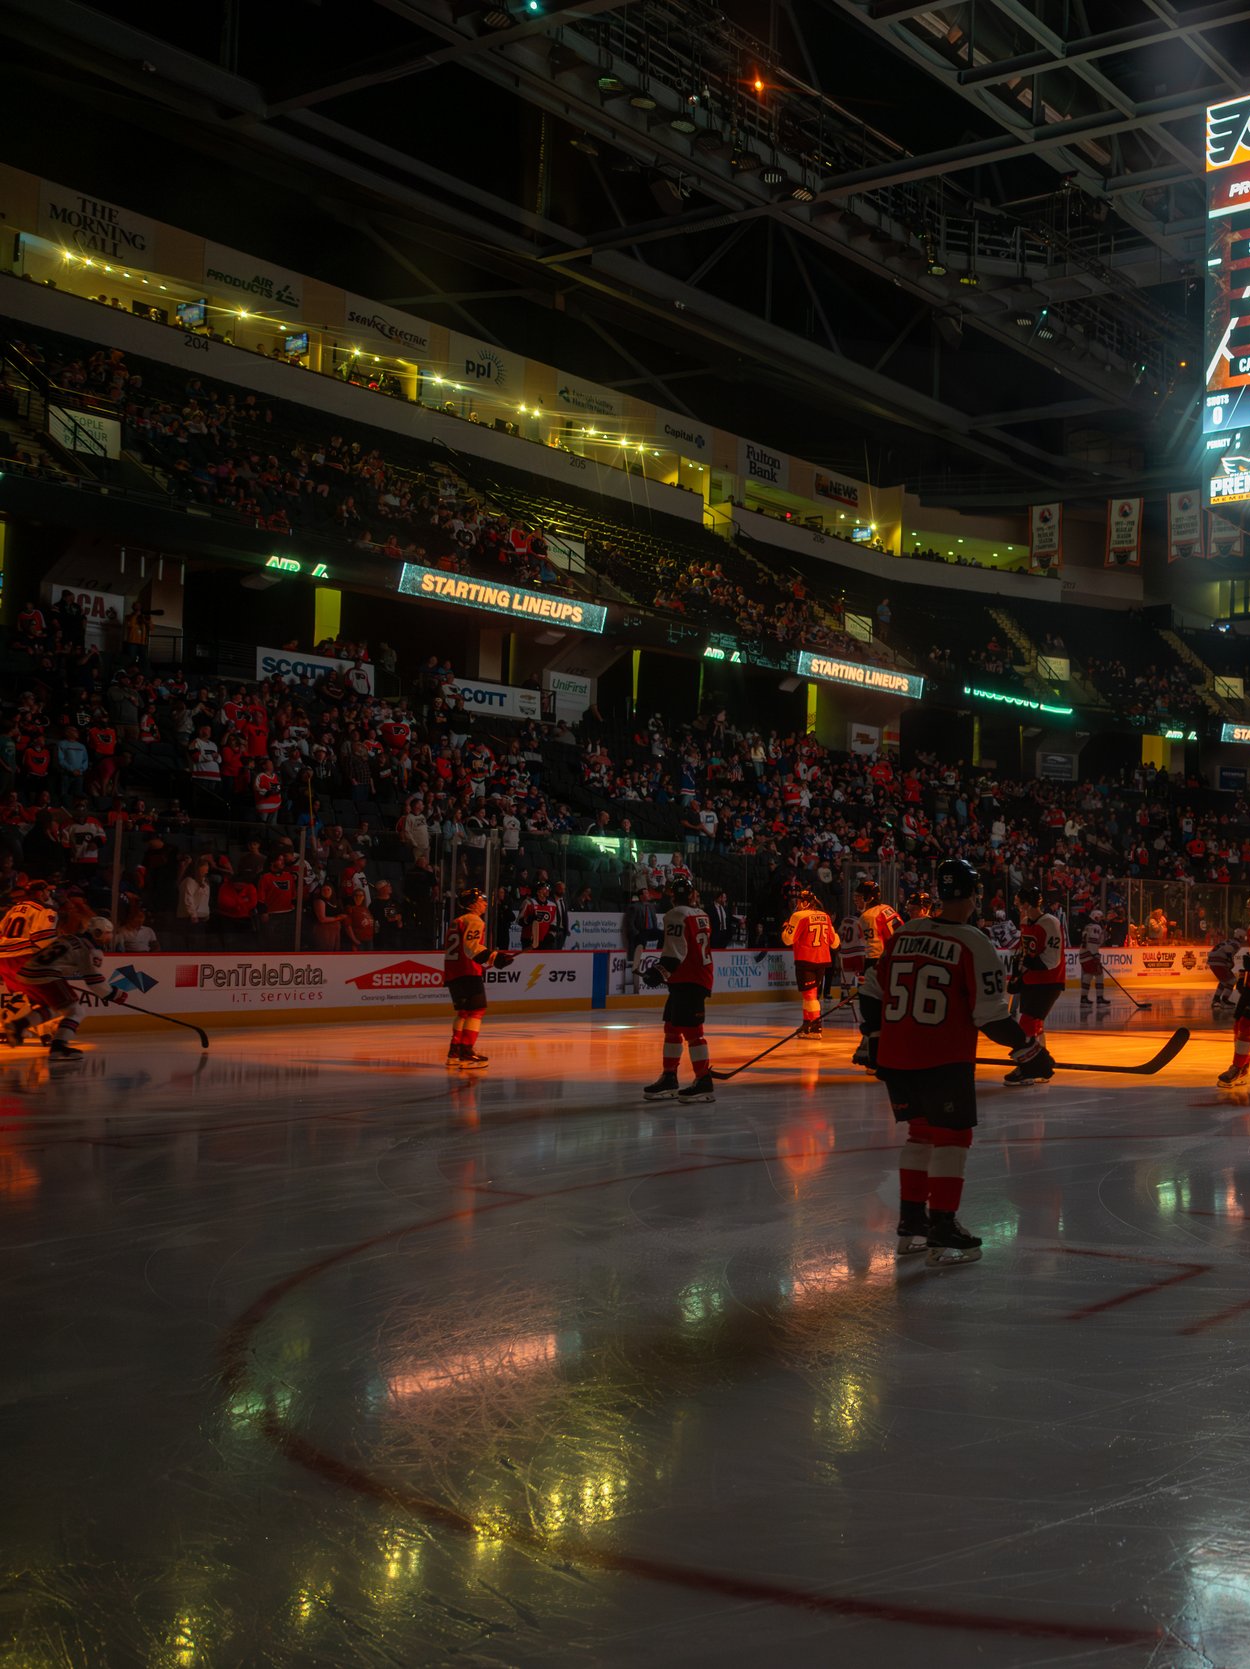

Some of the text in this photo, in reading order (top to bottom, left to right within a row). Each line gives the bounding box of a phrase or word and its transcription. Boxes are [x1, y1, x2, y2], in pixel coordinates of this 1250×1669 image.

[77, 196, 120, 226] THE
[49, 203, 146, 251] MORNING
[72, 229, 124, 260] CALL
[206, 268, 273, 299] PRODUCTS
[251, 275, 274, 290] AIR
[184, 333, 210, 352] 204
[465, 358, 492, 379] ppl
[1212, 407, 1224, 425] 0
[664, 424, 694, 443] Capital
[569, 456, 586, 470] 205
[746, 444, 781, 470] Fulton
[749, 460, 778, 484] Bank
[828, 479, 859, 502] NEWS
[421, 573, 583, 624] STARTING LINEUPS
[262, 656, 334, 680] SCOTT
[810, 658, 909, 692] STARTING LINEUPS
[552, 678, 588, 694] UniFirst
[582, 920, 617, 930] Lehigh Valley
[666, 924, 682, 937] 20
[466, 930, 480, 941] 62
[808, 924, 829, 947] 75
[1047, 938, 1061, 949] 42
[900, 936, 955, 961] TUOMAALA
[1143, 952, 1157, 962] DUAL
[731, 955, 749, 966] THE
[199, 962, 324, 988] PenTeleData
[548, 970, 576, 982] 375
[717, 964, 762, 977] MORNING
[728, 975, 751, 988] CALL
[231, 990, 324, 1003] I.T. services
[885, 960, 951, 1026] 56
